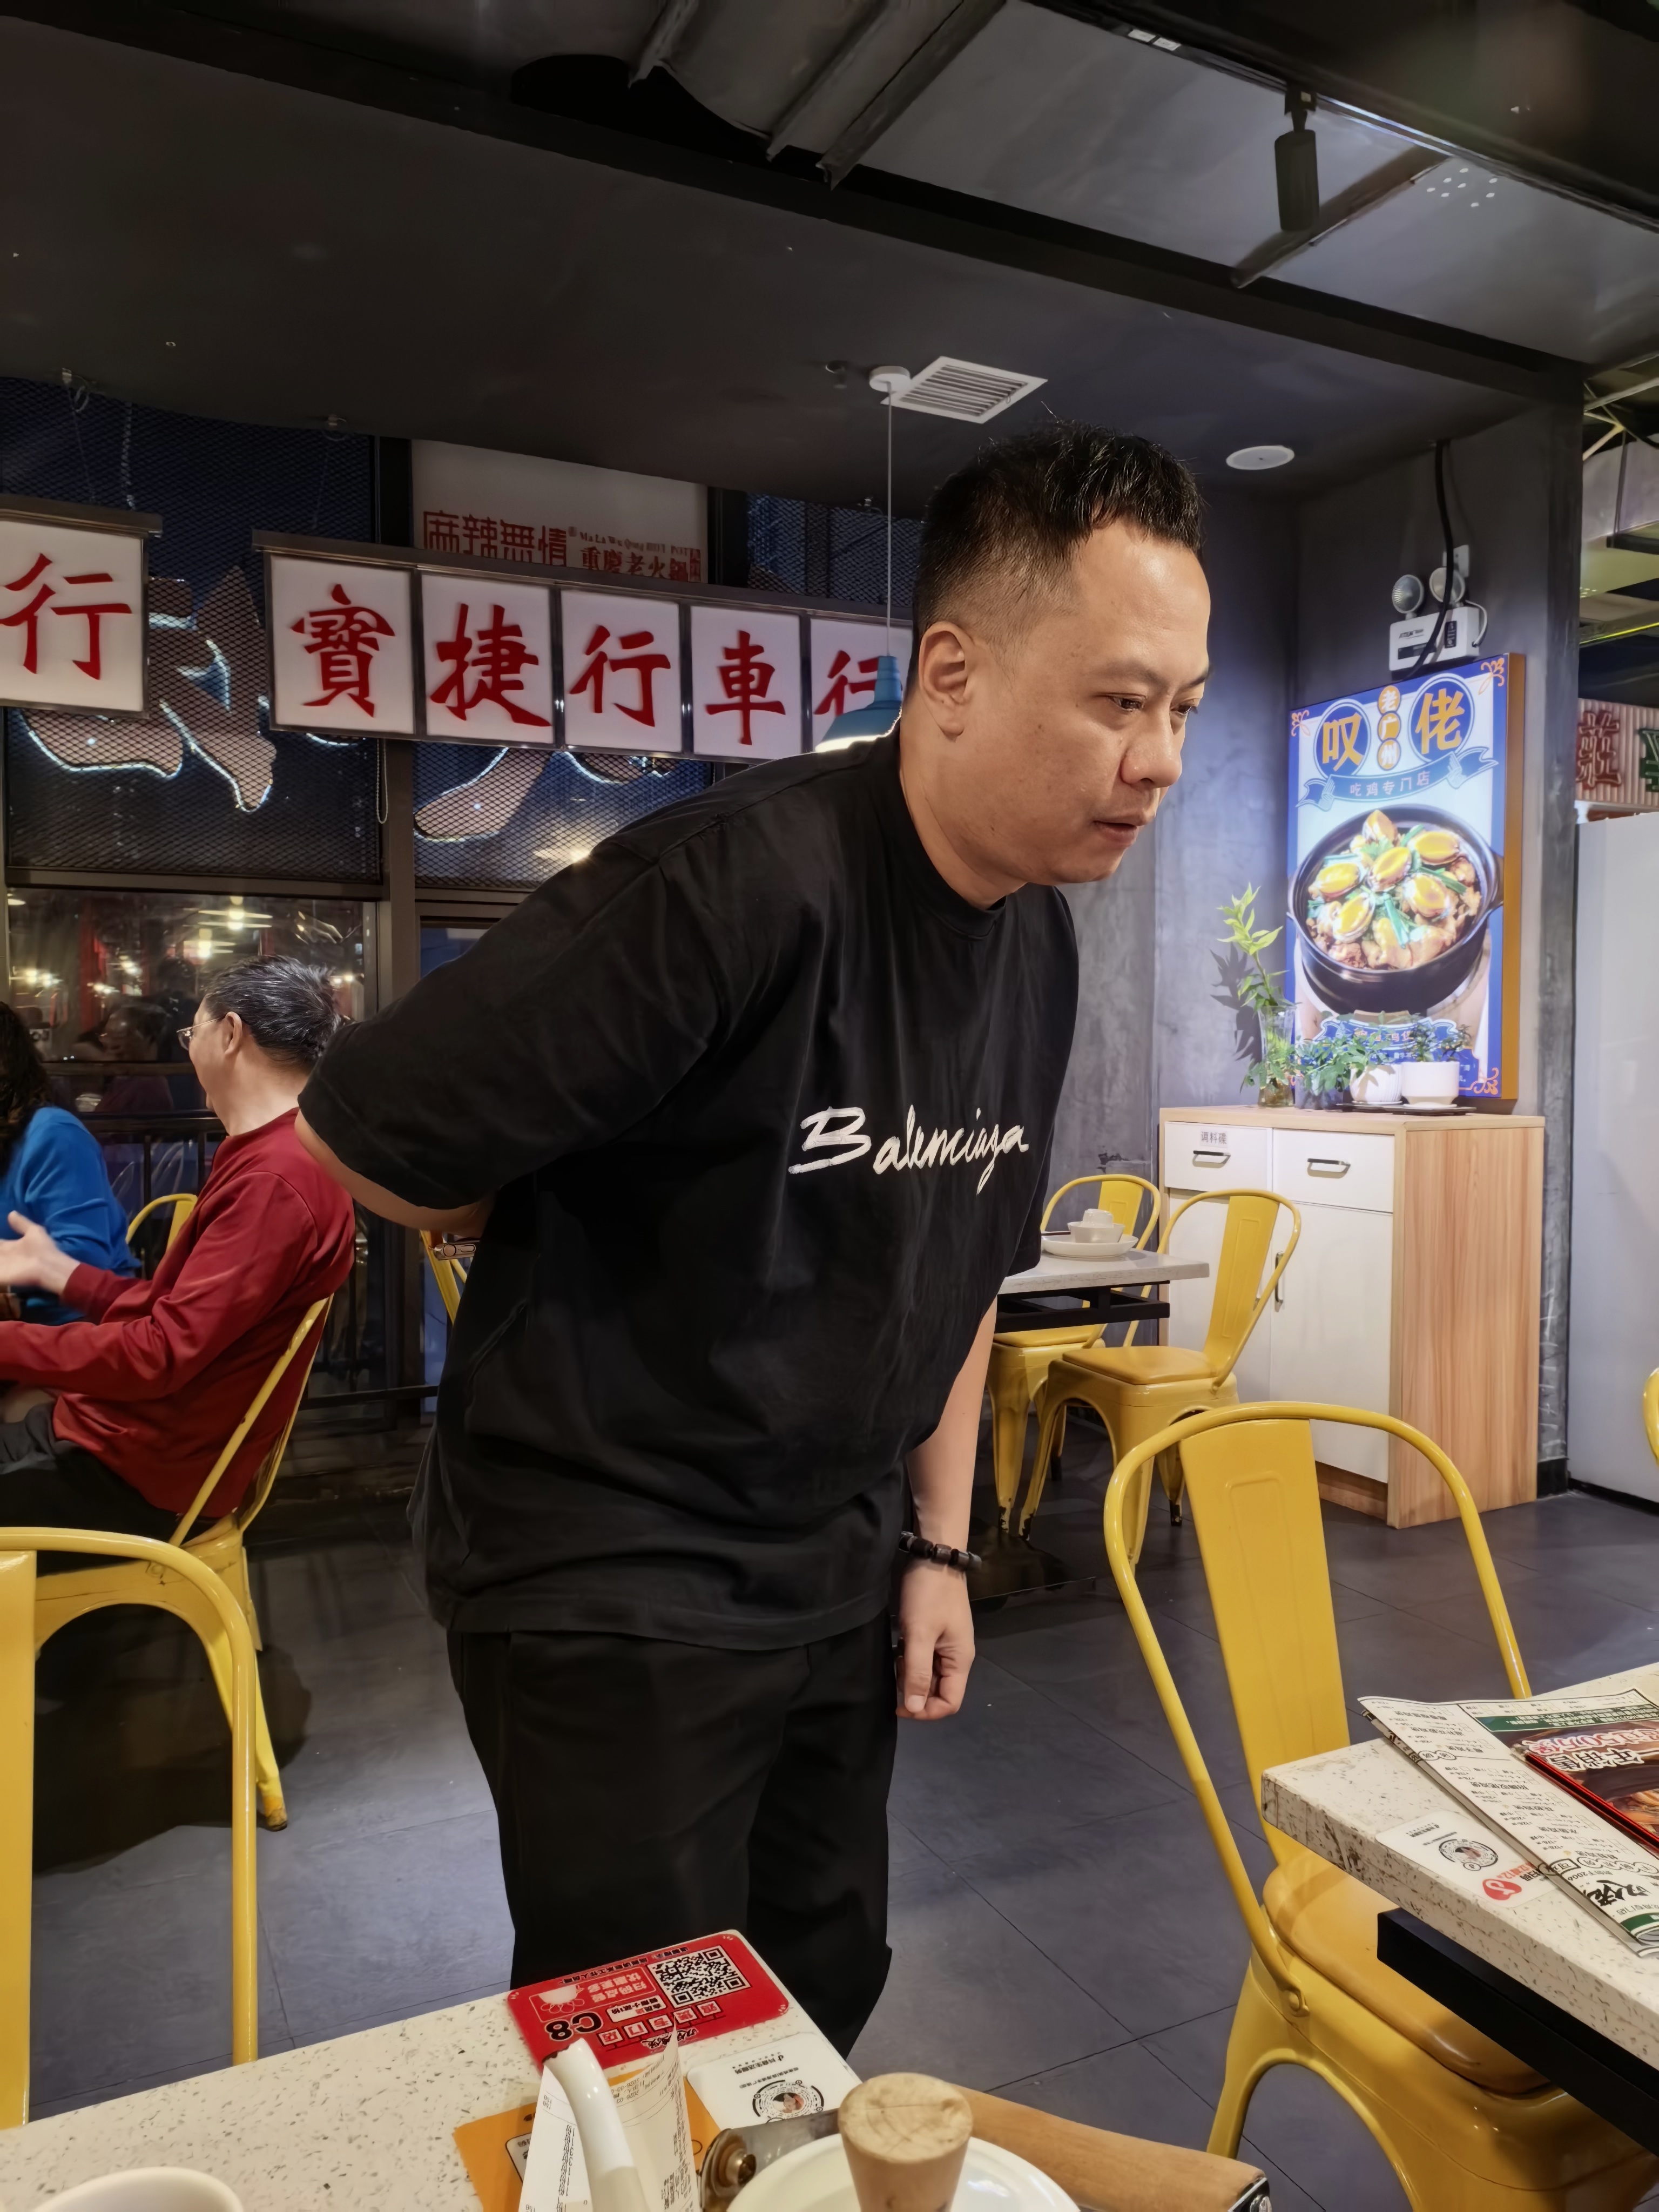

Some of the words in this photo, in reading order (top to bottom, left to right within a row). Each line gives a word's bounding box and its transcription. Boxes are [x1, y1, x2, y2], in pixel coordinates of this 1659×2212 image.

[0, 552, 132, 680] 行
[1380, 689, 1398, 767] 老广州
[1350, 770, 1431, 798] 吃鸡专门店
[1201, 1131, 1228, 1144] 调料碟
[544, 2011, 603, 2041] C8
